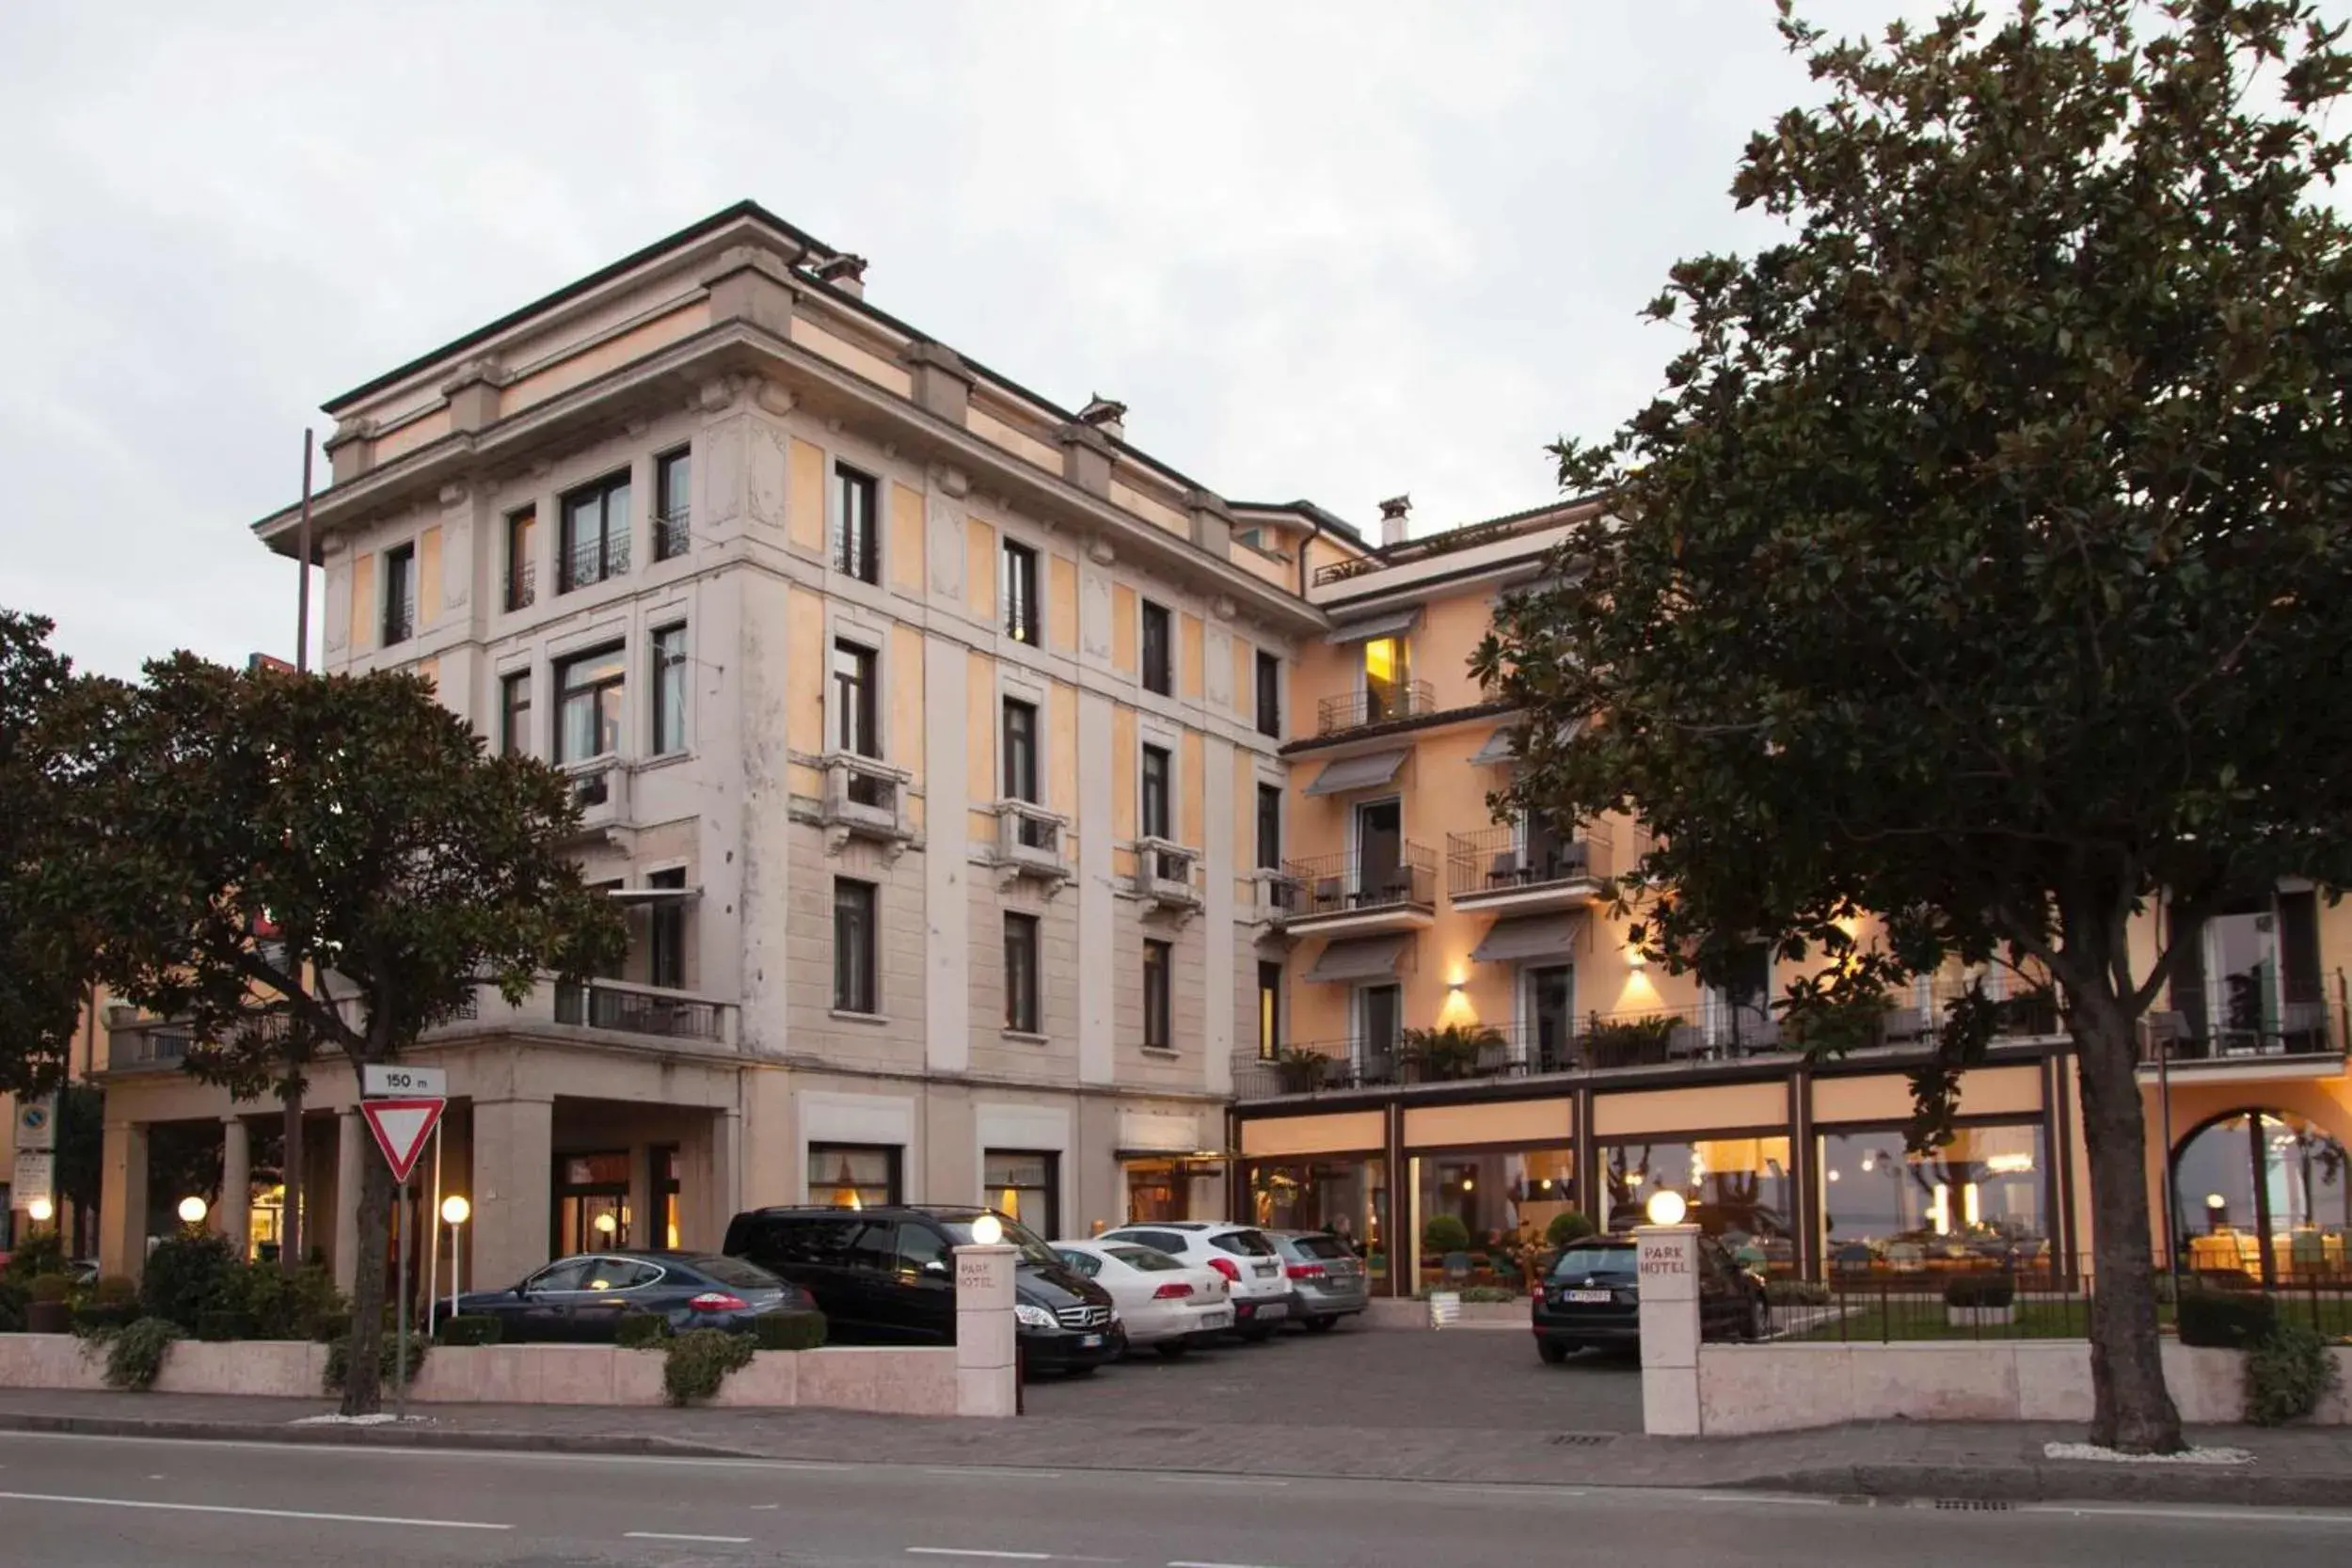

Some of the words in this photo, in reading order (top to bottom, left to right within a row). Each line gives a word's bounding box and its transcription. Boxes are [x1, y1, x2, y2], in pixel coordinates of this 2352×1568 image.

[386, 1073, 411, 1087] 150
[417, 1080, 428, 1088] m
[1644, 1245, 1684, 1259] PARK
[1640, 1261, 1691, 1275] HOTEL
